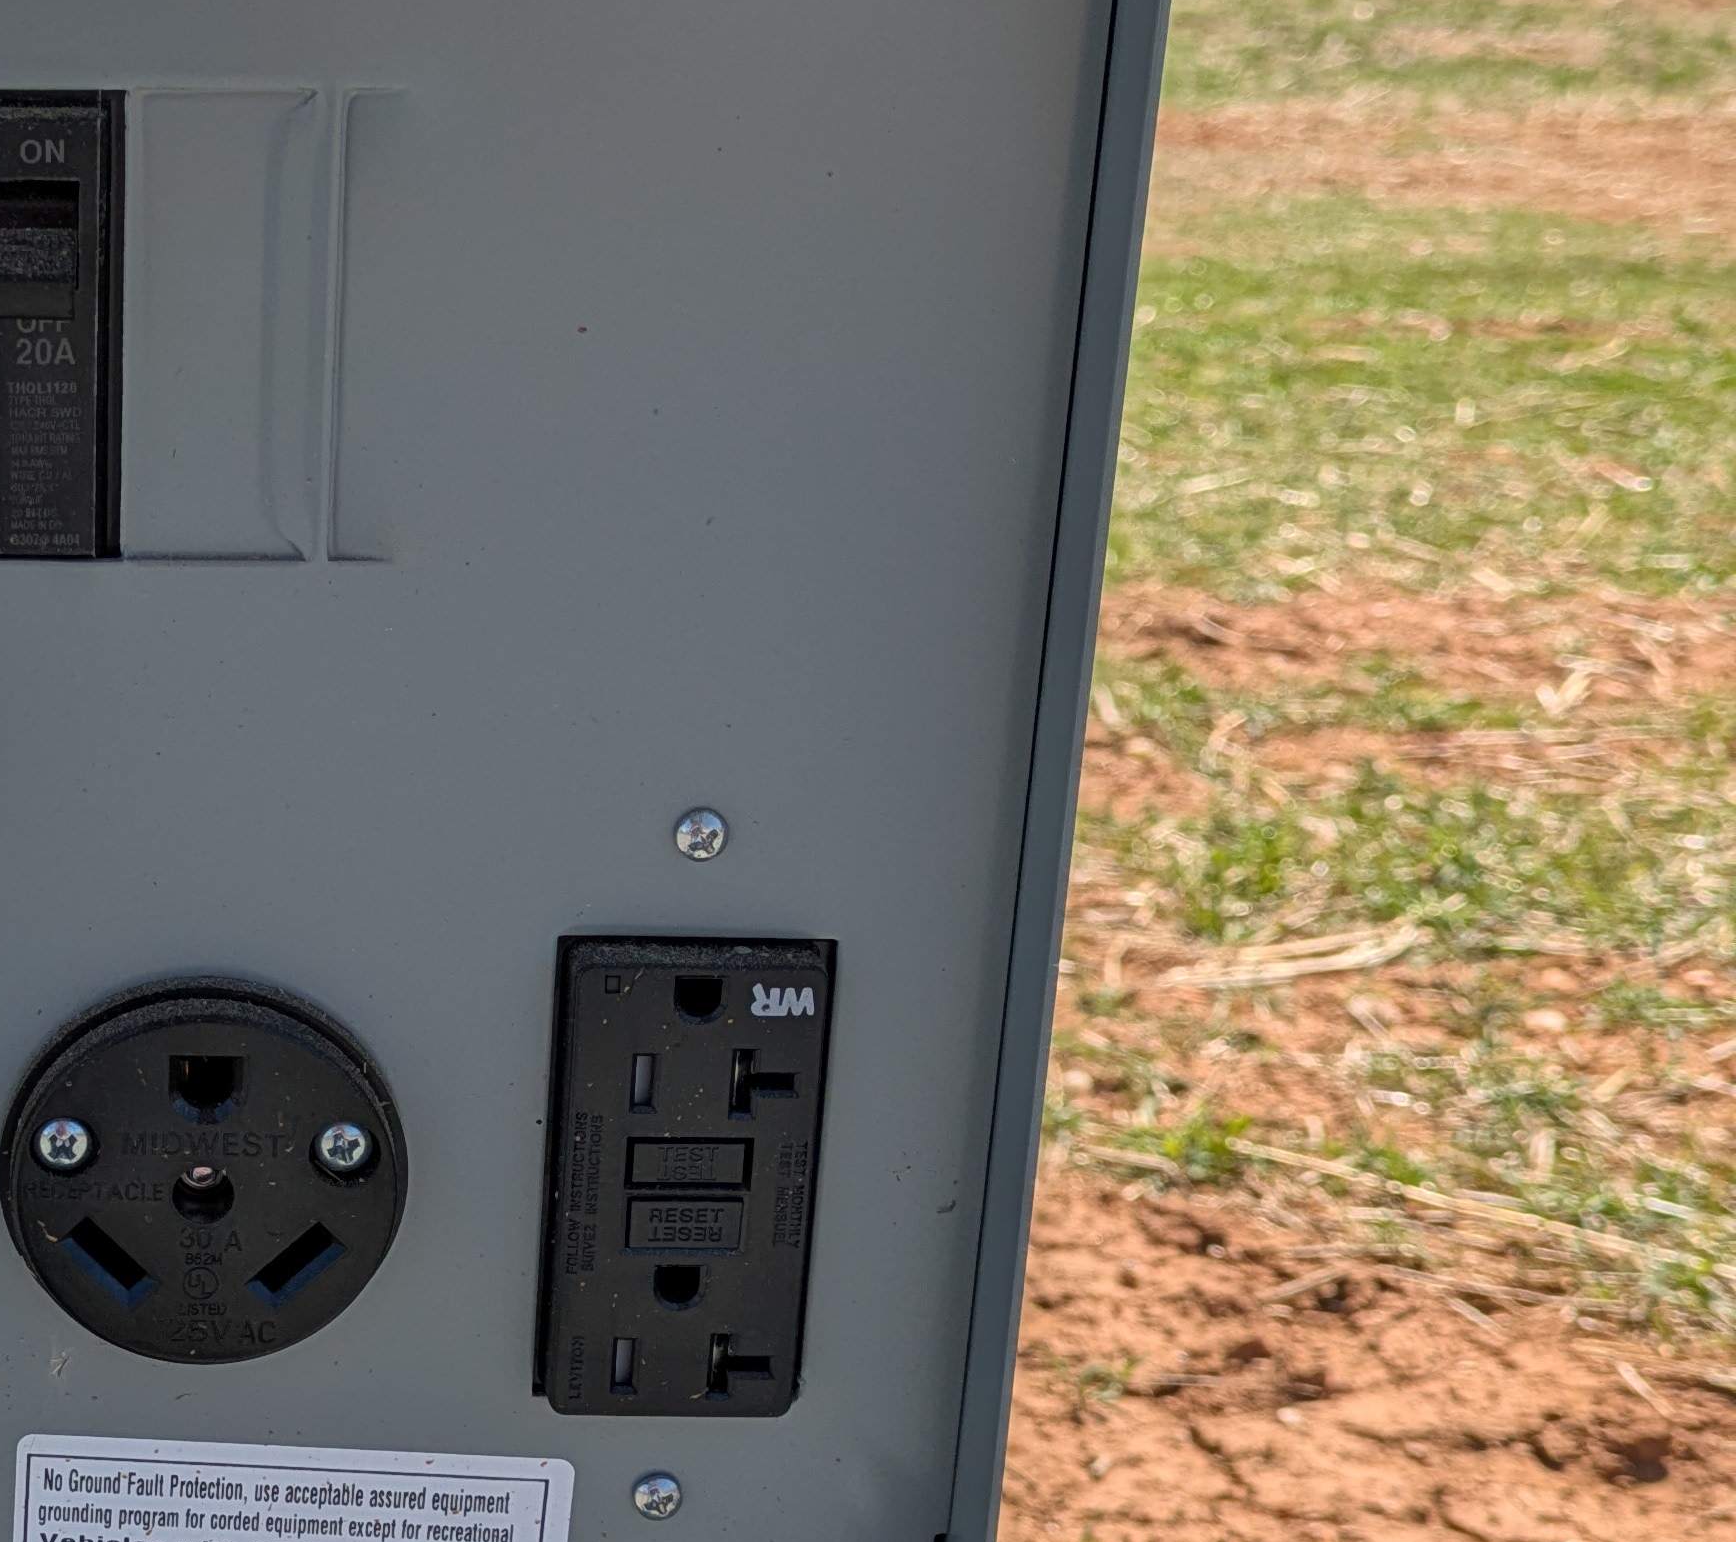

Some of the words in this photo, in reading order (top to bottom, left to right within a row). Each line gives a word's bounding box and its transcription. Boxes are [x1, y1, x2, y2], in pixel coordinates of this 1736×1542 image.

[20, 139, 64, 163] ON
[16, 338, 76, 364] 20A
[750, 983, 815, 1017] WR
[648, 1208, 724, 1223] RESET
[648, 1226, 722, 1242] RESET
[44, 1468, 63, 1492] No
[69, 1469, 121, 1495] Ground
[128, 1474, 164, 1497] Fault
[170, 1476, 248, 1504] Protection,
[256, 1485, 280, 1504] use
[285, 1481, 364, 1509] acceptable
[369, 1487, 427, 1510] assured
[433, 1489, 511, 1517] equipment
[39, 1505, 113, 1529] grounding
[119, 1509, 180, 1533] program
[186, 1510, 206, 1530] for
[211, 1511, 260, 1532] corded
[266, 1514, 344, 1539] equipment
[349, 1519, 397, 1542] except
[402, 1519, 422, 1540] for
